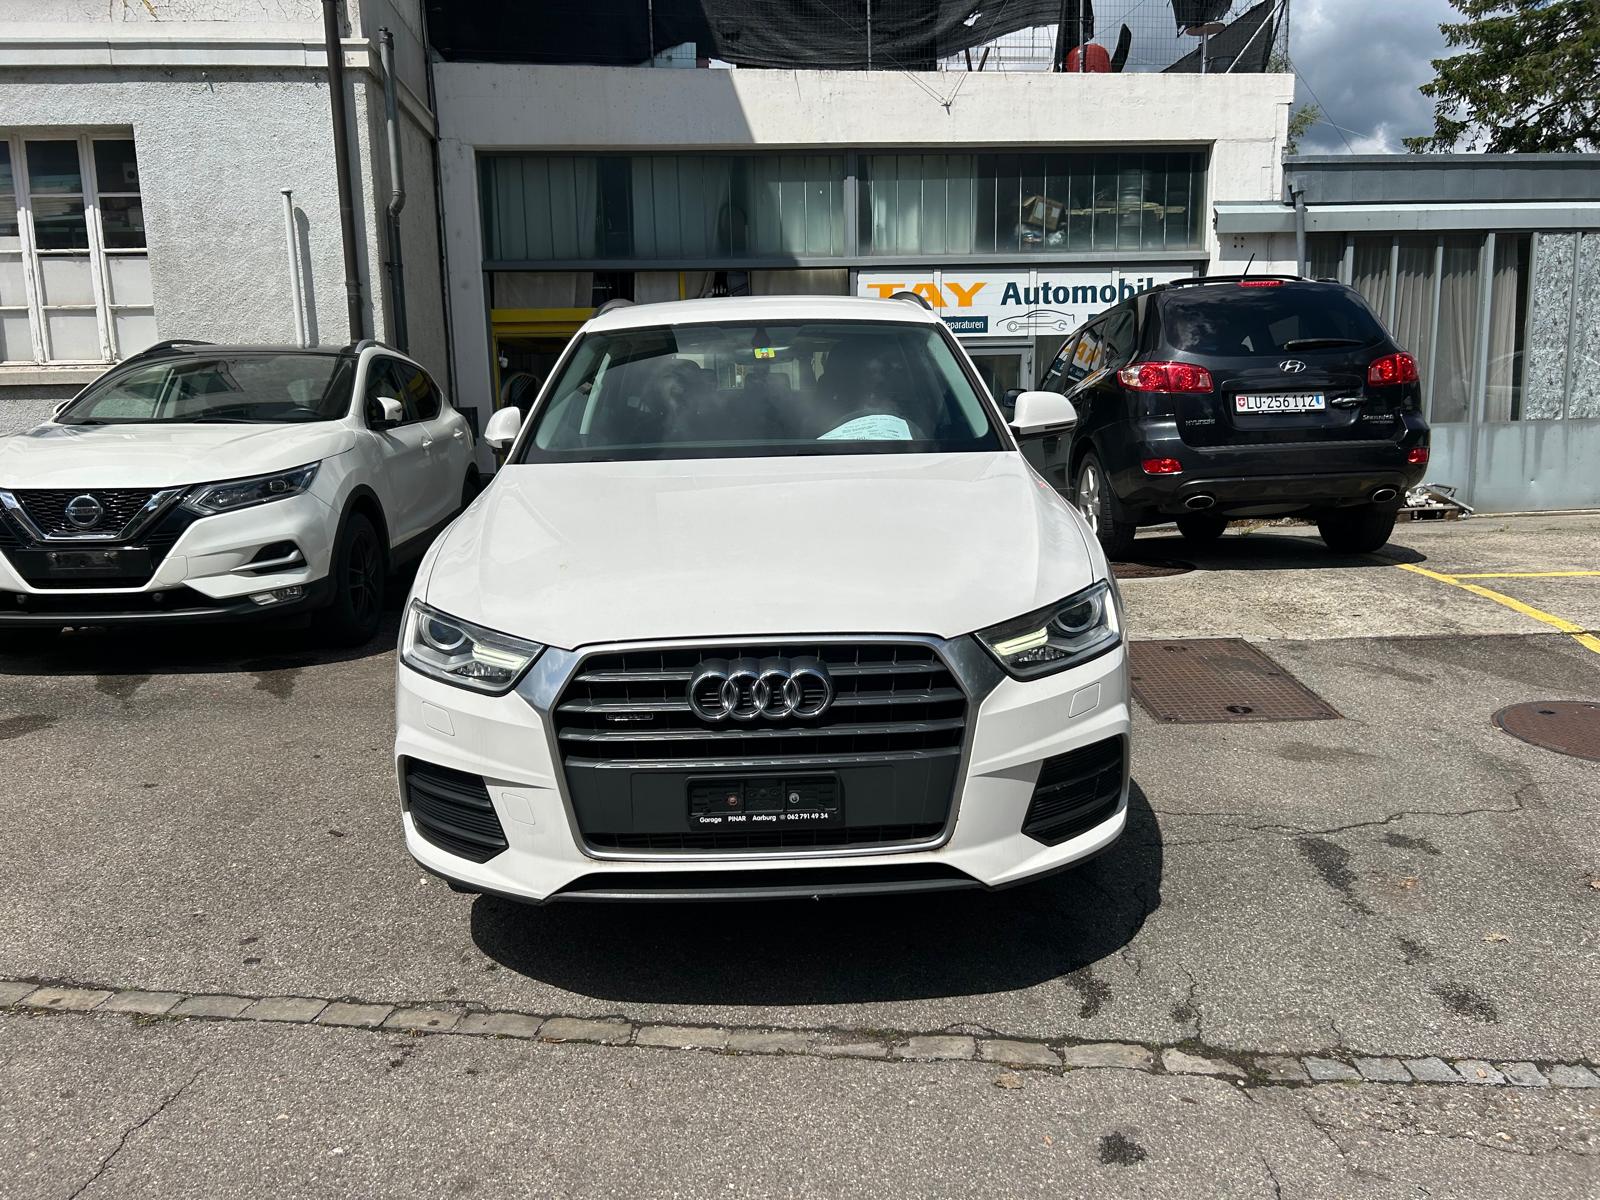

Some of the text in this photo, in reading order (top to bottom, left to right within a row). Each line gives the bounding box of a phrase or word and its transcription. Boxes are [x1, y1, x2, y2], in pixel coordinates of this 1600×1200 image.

[867, 282, 988, 307] TAY
[944, 319, 984, 329] eparaturen
[699, 816, 723, 824] Garage
[752, 814, 777, 822] Aarburg
